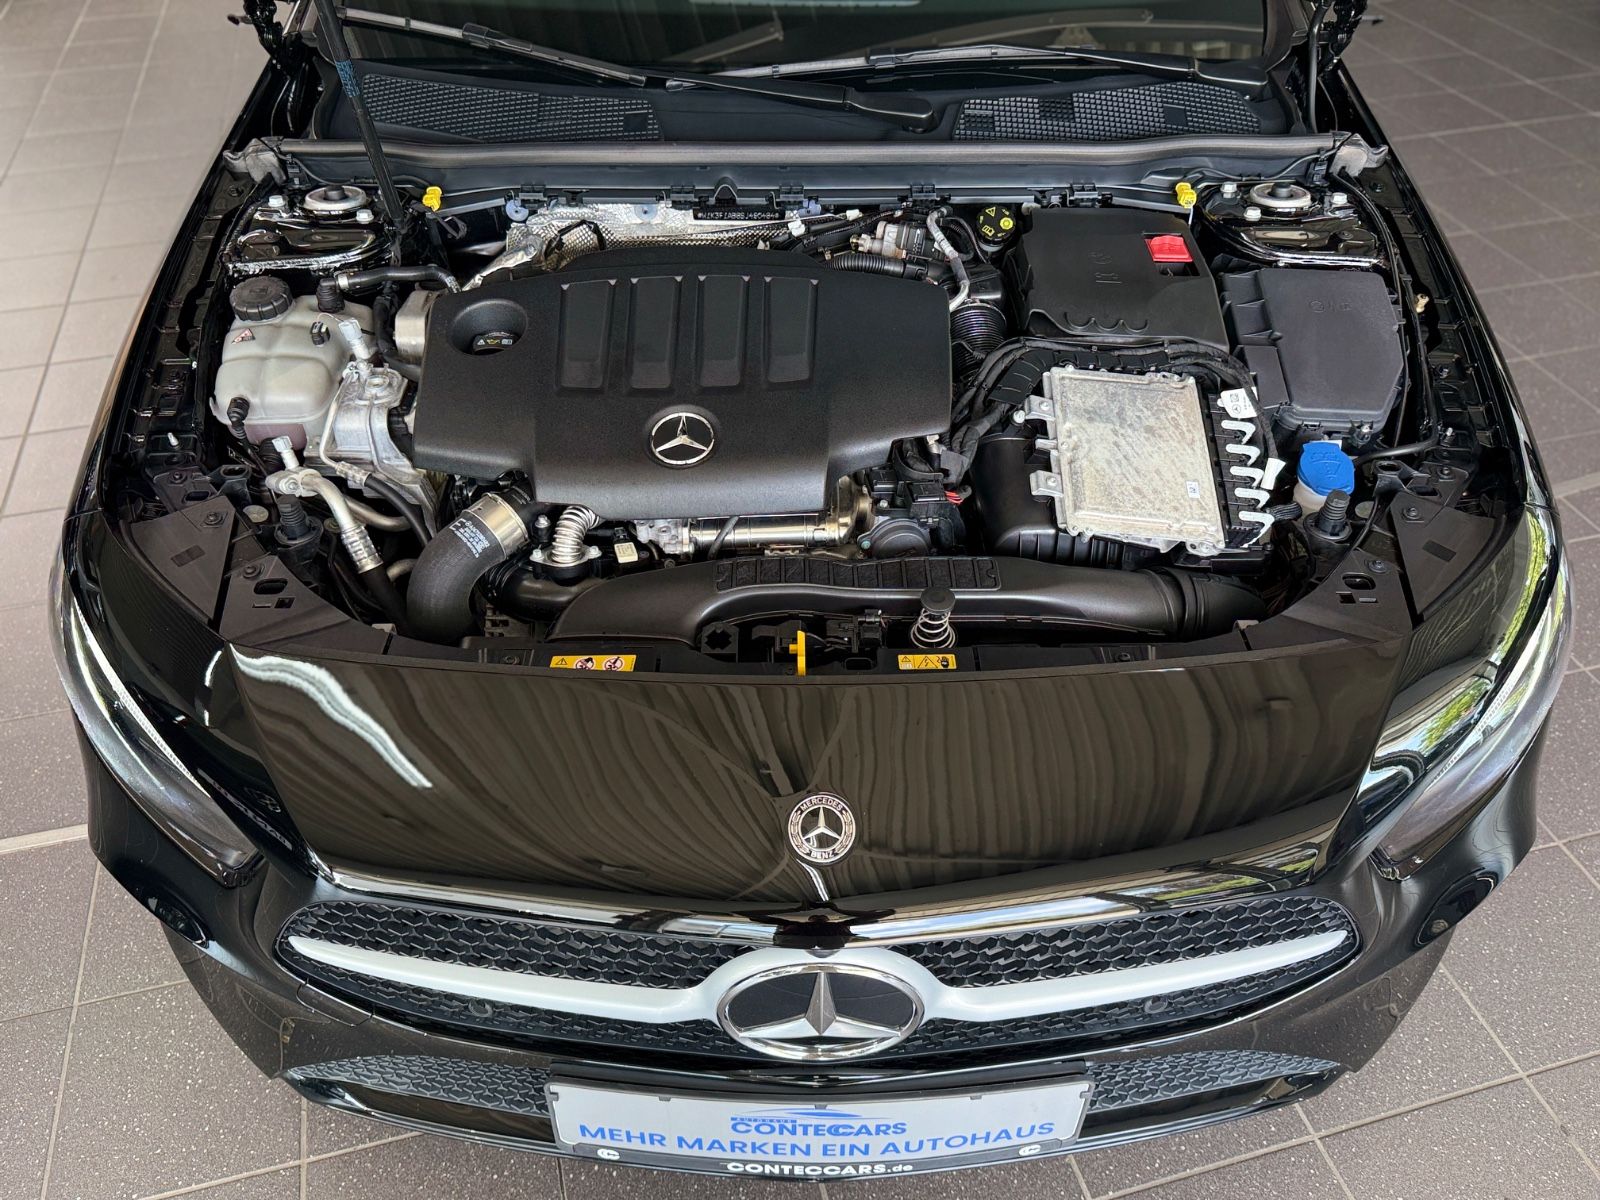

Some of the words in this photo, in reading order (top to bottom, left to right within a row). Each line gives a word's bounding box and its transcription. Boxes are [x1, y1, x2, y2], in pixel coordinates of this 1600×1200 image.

[800, 798, 842, 811] MERCEDES
[811, 850, 834, 858] BENZ
[731, 1122, 907, 1136] CONTECCARS
[579, 1124, 666, 1147] MEHR
[677, 1136, 811, 1156] MARKEN
[822, 1144, 869, 1156] EIN
[880, 1122, 1055, 1154] AUTOHAUS
[727, 1162, 913, 1175] CONTECCARS.de
